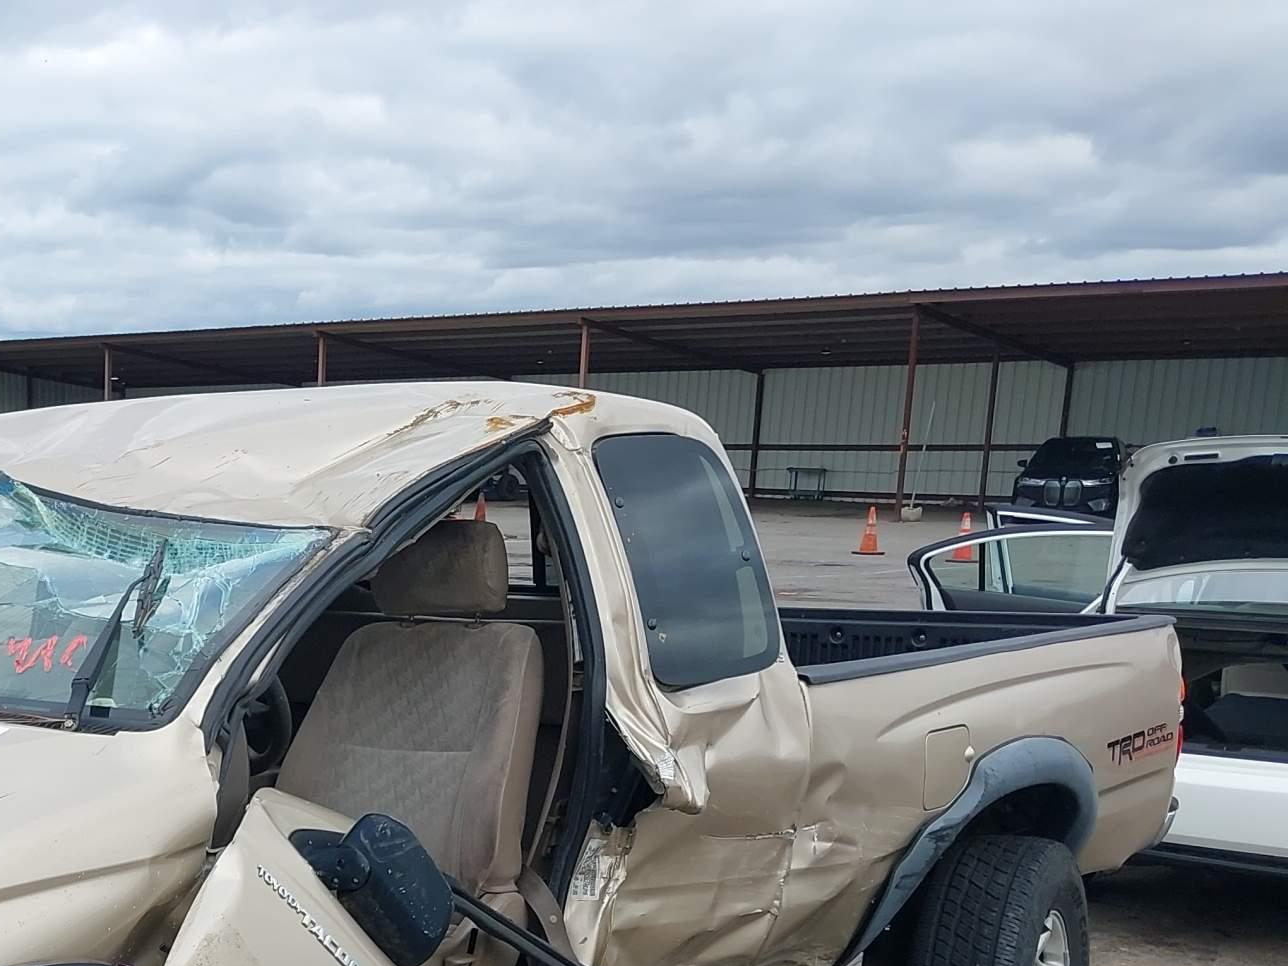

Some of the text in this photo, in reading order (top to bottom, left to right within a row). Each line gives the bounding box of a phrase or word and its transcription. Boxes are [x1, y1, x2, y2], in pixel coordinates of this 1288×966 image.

[1145, 731, 1174, 748] ROAD
[1146, 722, 1168, 737] OFF
[1107, 730, 1145, 766] TRD
[257, 864, 306, 915] TOYOTA
